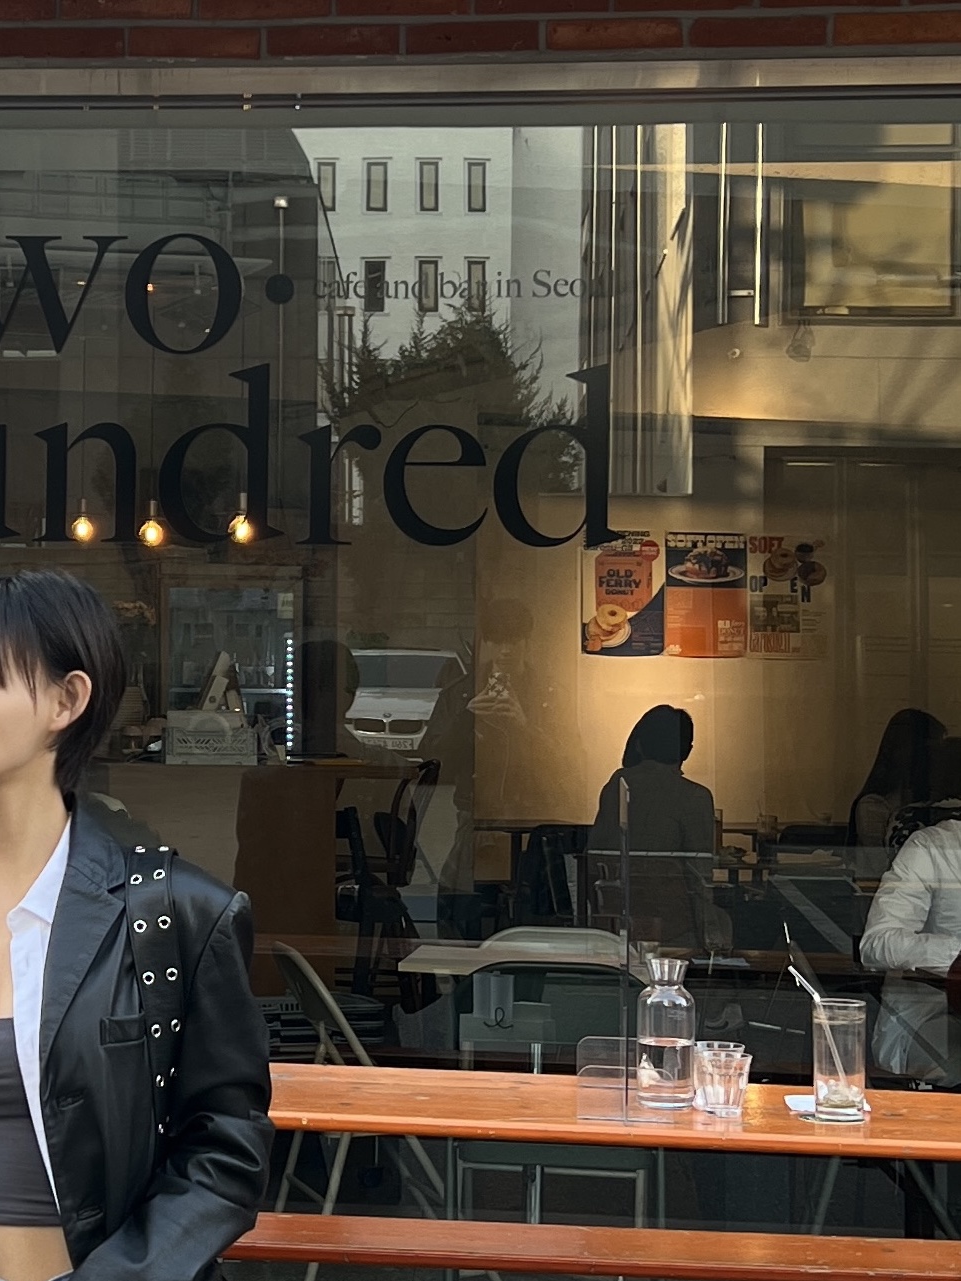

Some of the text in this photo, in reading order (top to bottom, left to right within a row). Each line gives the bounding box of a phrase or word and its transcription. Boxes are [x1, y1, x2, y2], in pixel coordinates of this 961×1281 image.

[314, 271, 367, 300] cafe
[375, 269, 431, 300] and
[439, 268, 489, 300] bar
[495, 271, 522, 299] in
[749, 536, 785, 554] SOFT
[607, 569, 633, 578] OLD
[598, 576, 641, 589] FERRY
[605, 588, 635, 596] DONUT
